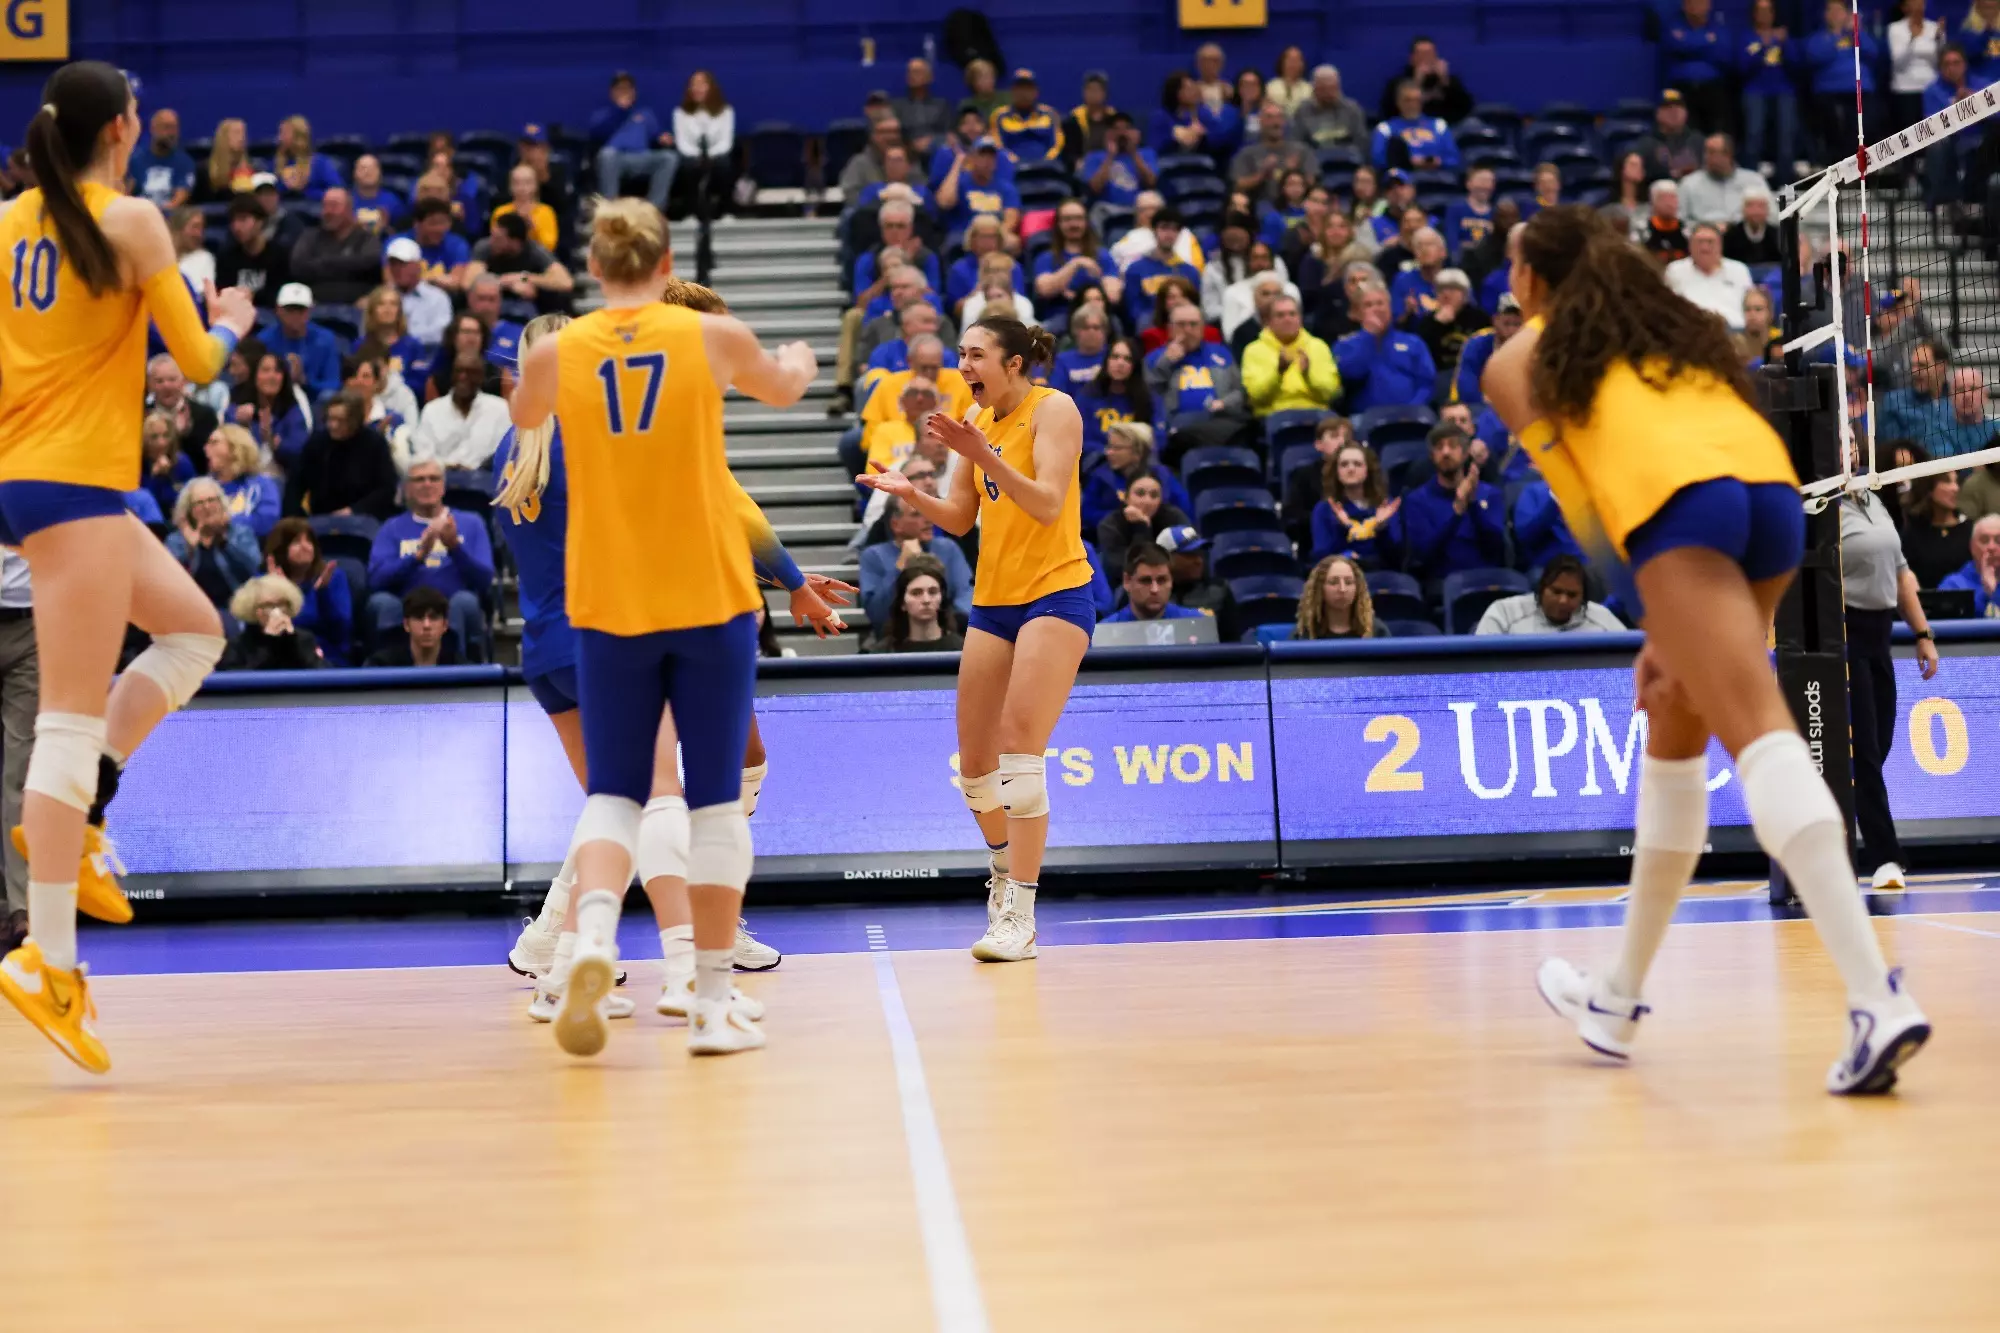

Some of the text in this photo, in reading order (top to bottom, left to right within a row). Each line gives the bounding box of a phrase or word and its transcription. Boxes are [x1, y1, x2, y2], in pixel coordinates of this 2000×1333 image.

[7, 0, 43, 38] G
[1914, 118, 1935, 142] UPMC
[1955, 96, 1978, 121] UPMC
[1875, 138, 1895, 161] UPMC
[13, 237, 57, 312] 10
[597, 352, 665, 434] 17
[983, 472, 1000, 502] 6
[1804, 681, 1825, 738] sports
[1364, 715, 1424, 792] 2
[1448, 698, 1732, 799] UPM
[1909, 697, 1970, 776] 0
[1113, 742, 1255, 785] WON
[844, 869, 939, 879] DAKTRONICS
